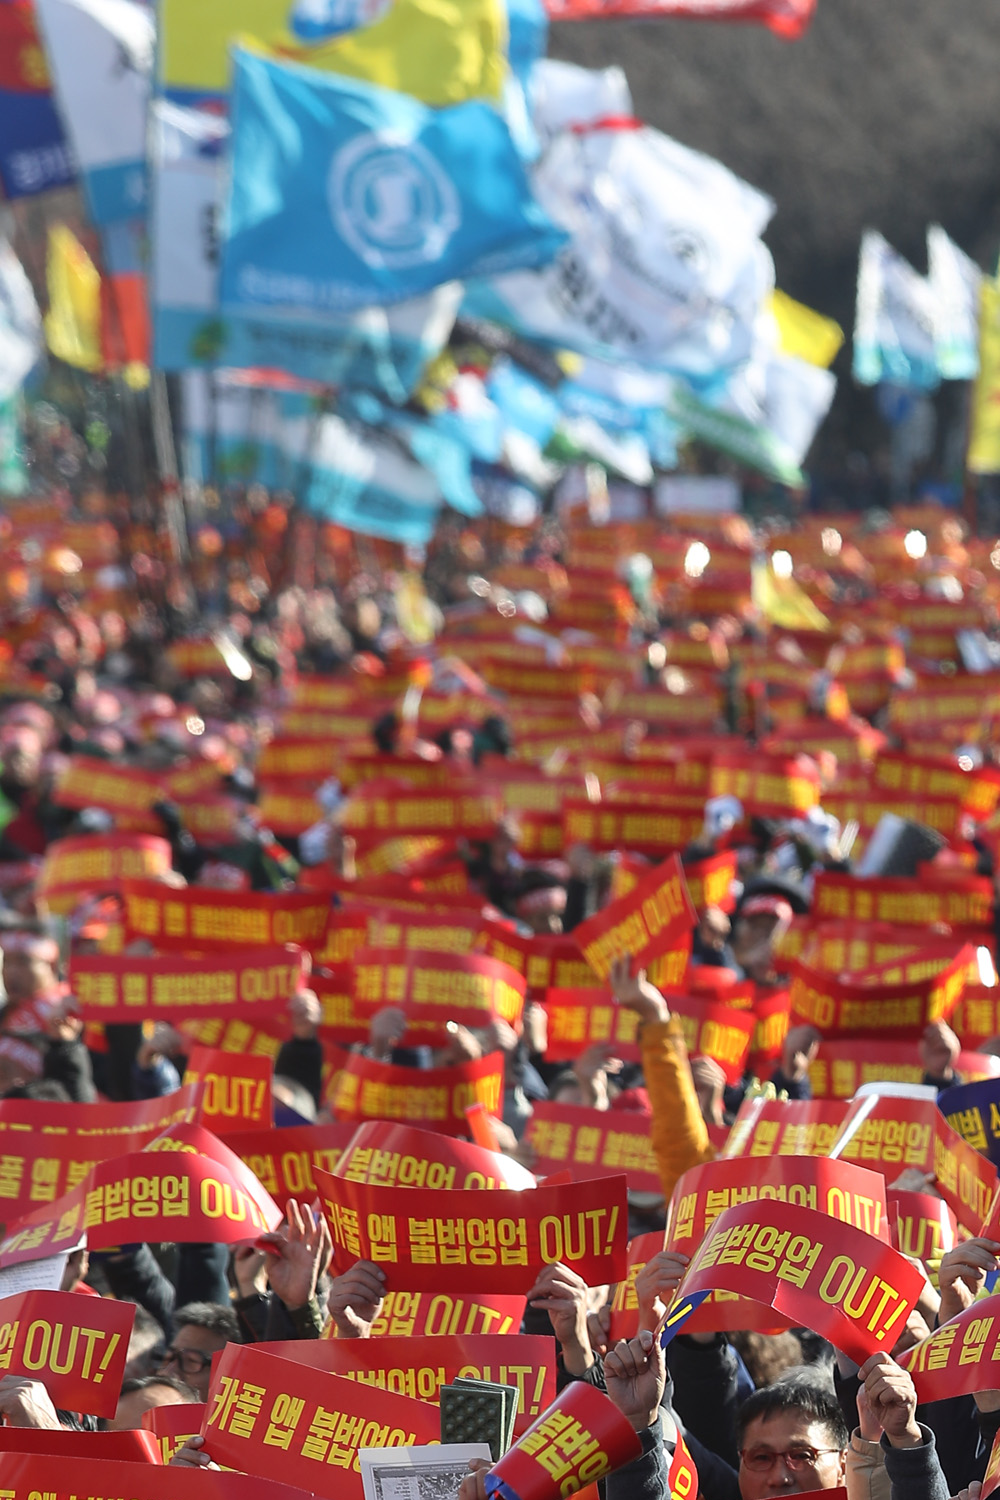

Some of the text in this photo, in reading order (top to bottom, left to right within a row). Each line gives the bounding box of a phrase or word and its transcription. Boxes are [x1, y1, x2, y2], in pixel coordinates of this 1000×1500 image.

[202, 1076, 267, 1120] OUT!
[30, 1158, 60, 1200] 앱
[84, 1175, 189, 1228] 불법영업
[324, 1197, 619, 1266] 카풀 앱 불법영업 OUT!
[818, 1254, 907, 1341] OUT!
[23, 1319, 121, 1384] OUT!
[962, 1315, 993, 1367] 앱
[207, 1375, 306, 1452] 카풀 앱
